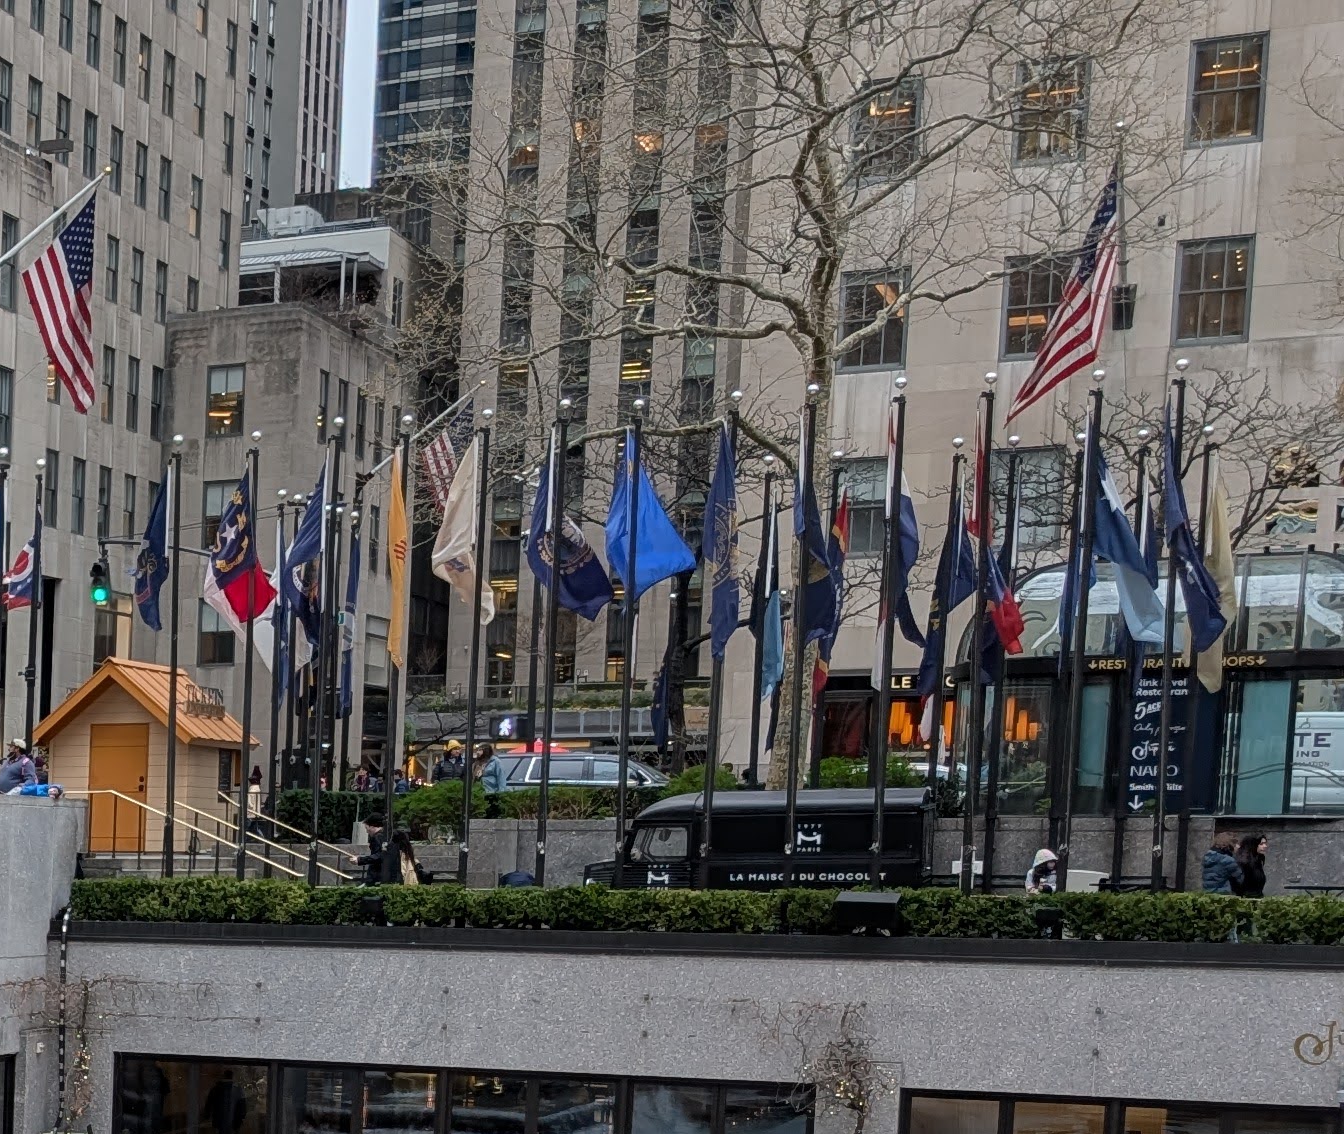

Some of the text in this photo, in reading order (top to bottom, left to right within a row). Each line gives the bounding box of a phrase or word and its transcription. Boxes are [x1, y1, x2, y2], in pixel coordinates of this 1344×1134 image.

[1134, 701, 1146, 720] 5
[729, 873, 743, 881] LA
[800, 873, 815, 881] DU
[819, 872, 886, 881] CHOCOLT
